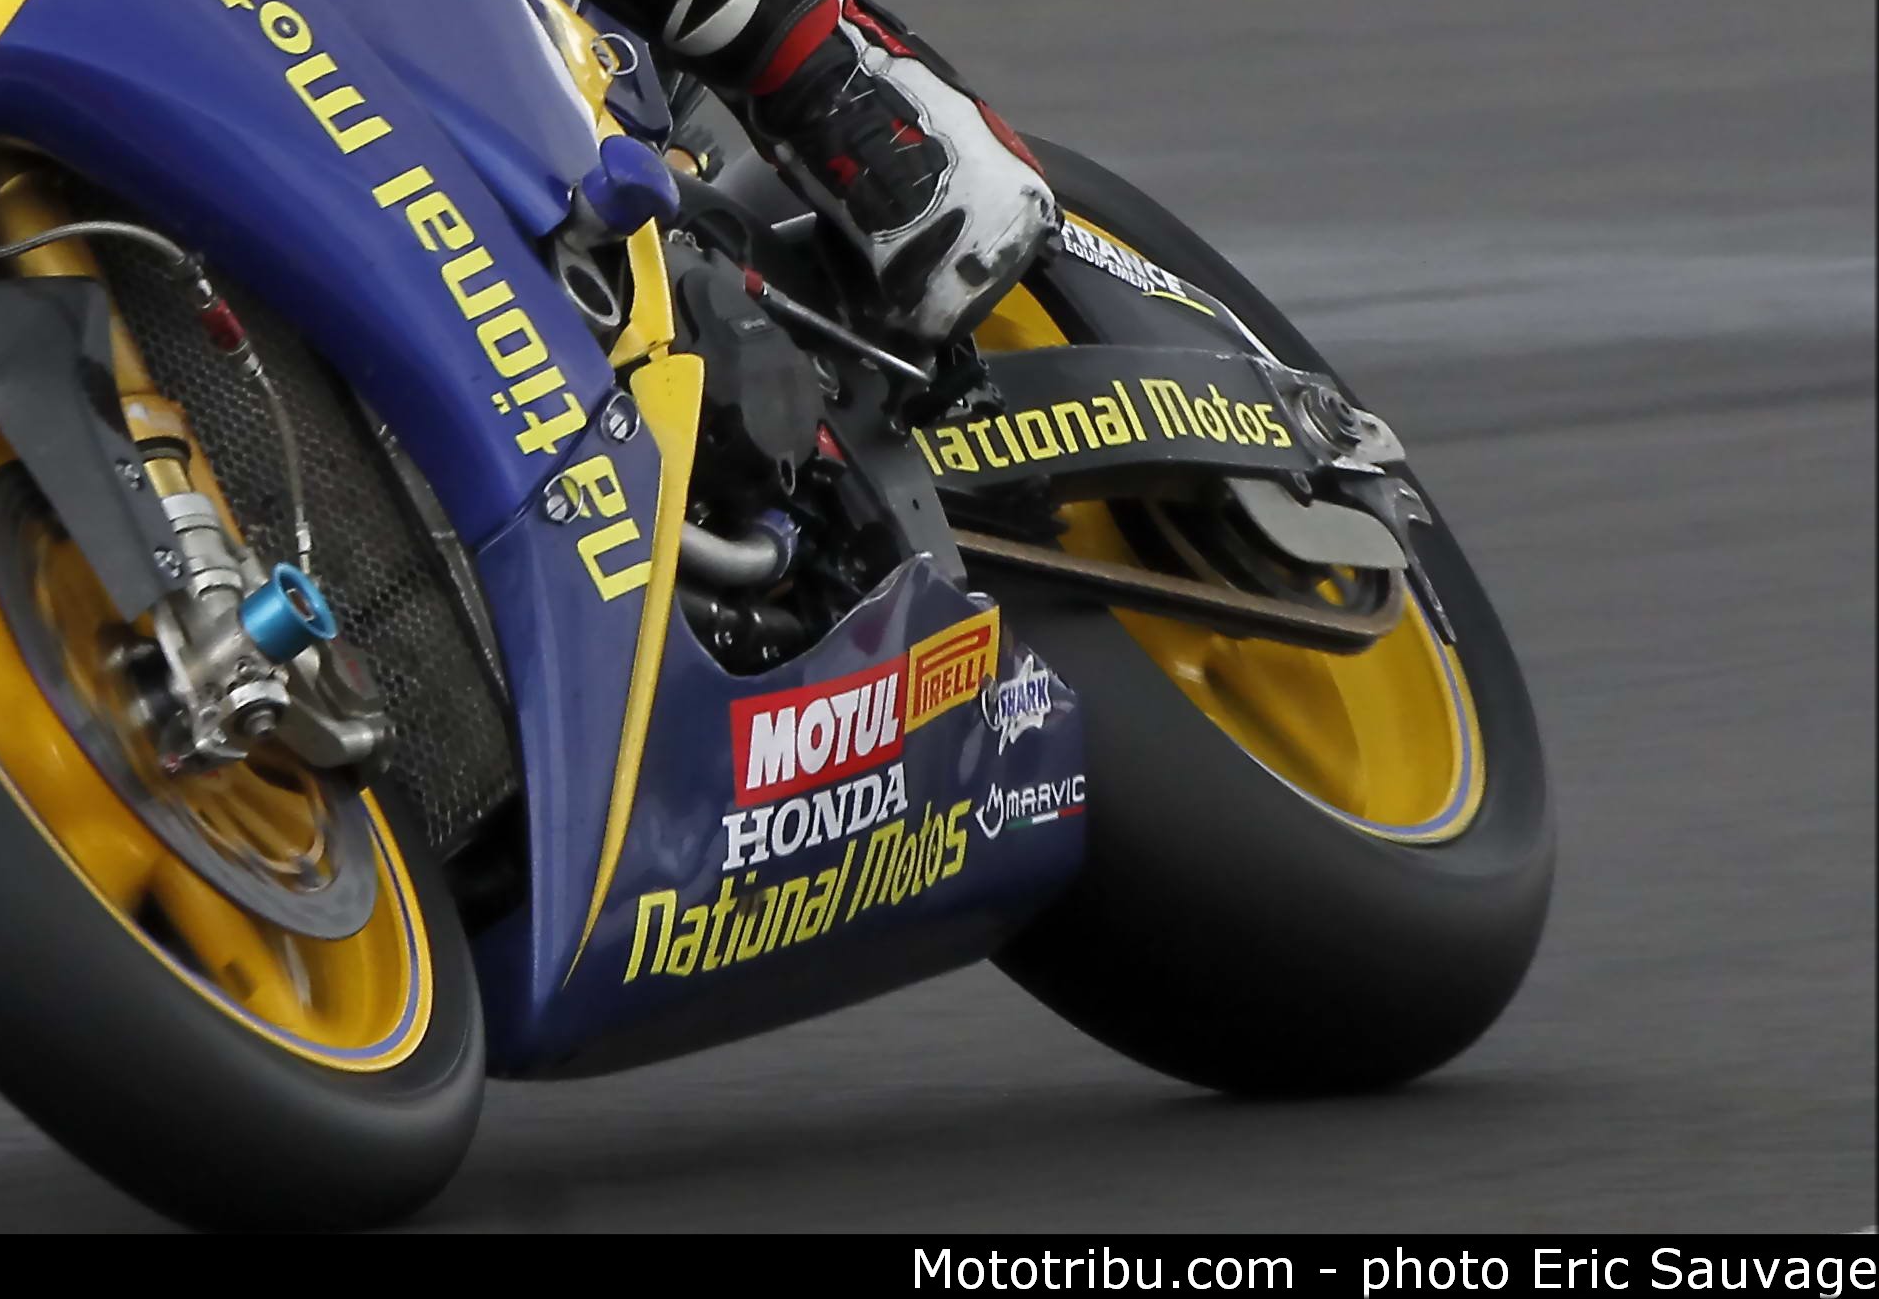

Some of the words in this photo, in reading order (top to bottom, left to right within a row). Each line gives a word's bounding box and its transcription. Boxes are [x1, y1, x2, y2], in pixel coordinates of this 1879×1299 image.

[1061, 219, 1188, 298] FRANCE
[912, 624, 991, 720] PIRELLI
[1000, 676, 1050, 719] SHARK
[744, 672, 900, 791] MOTUL
[721, 762, 909, 872] HONDA
[1005, 773, 1087, 821] MARVIC
